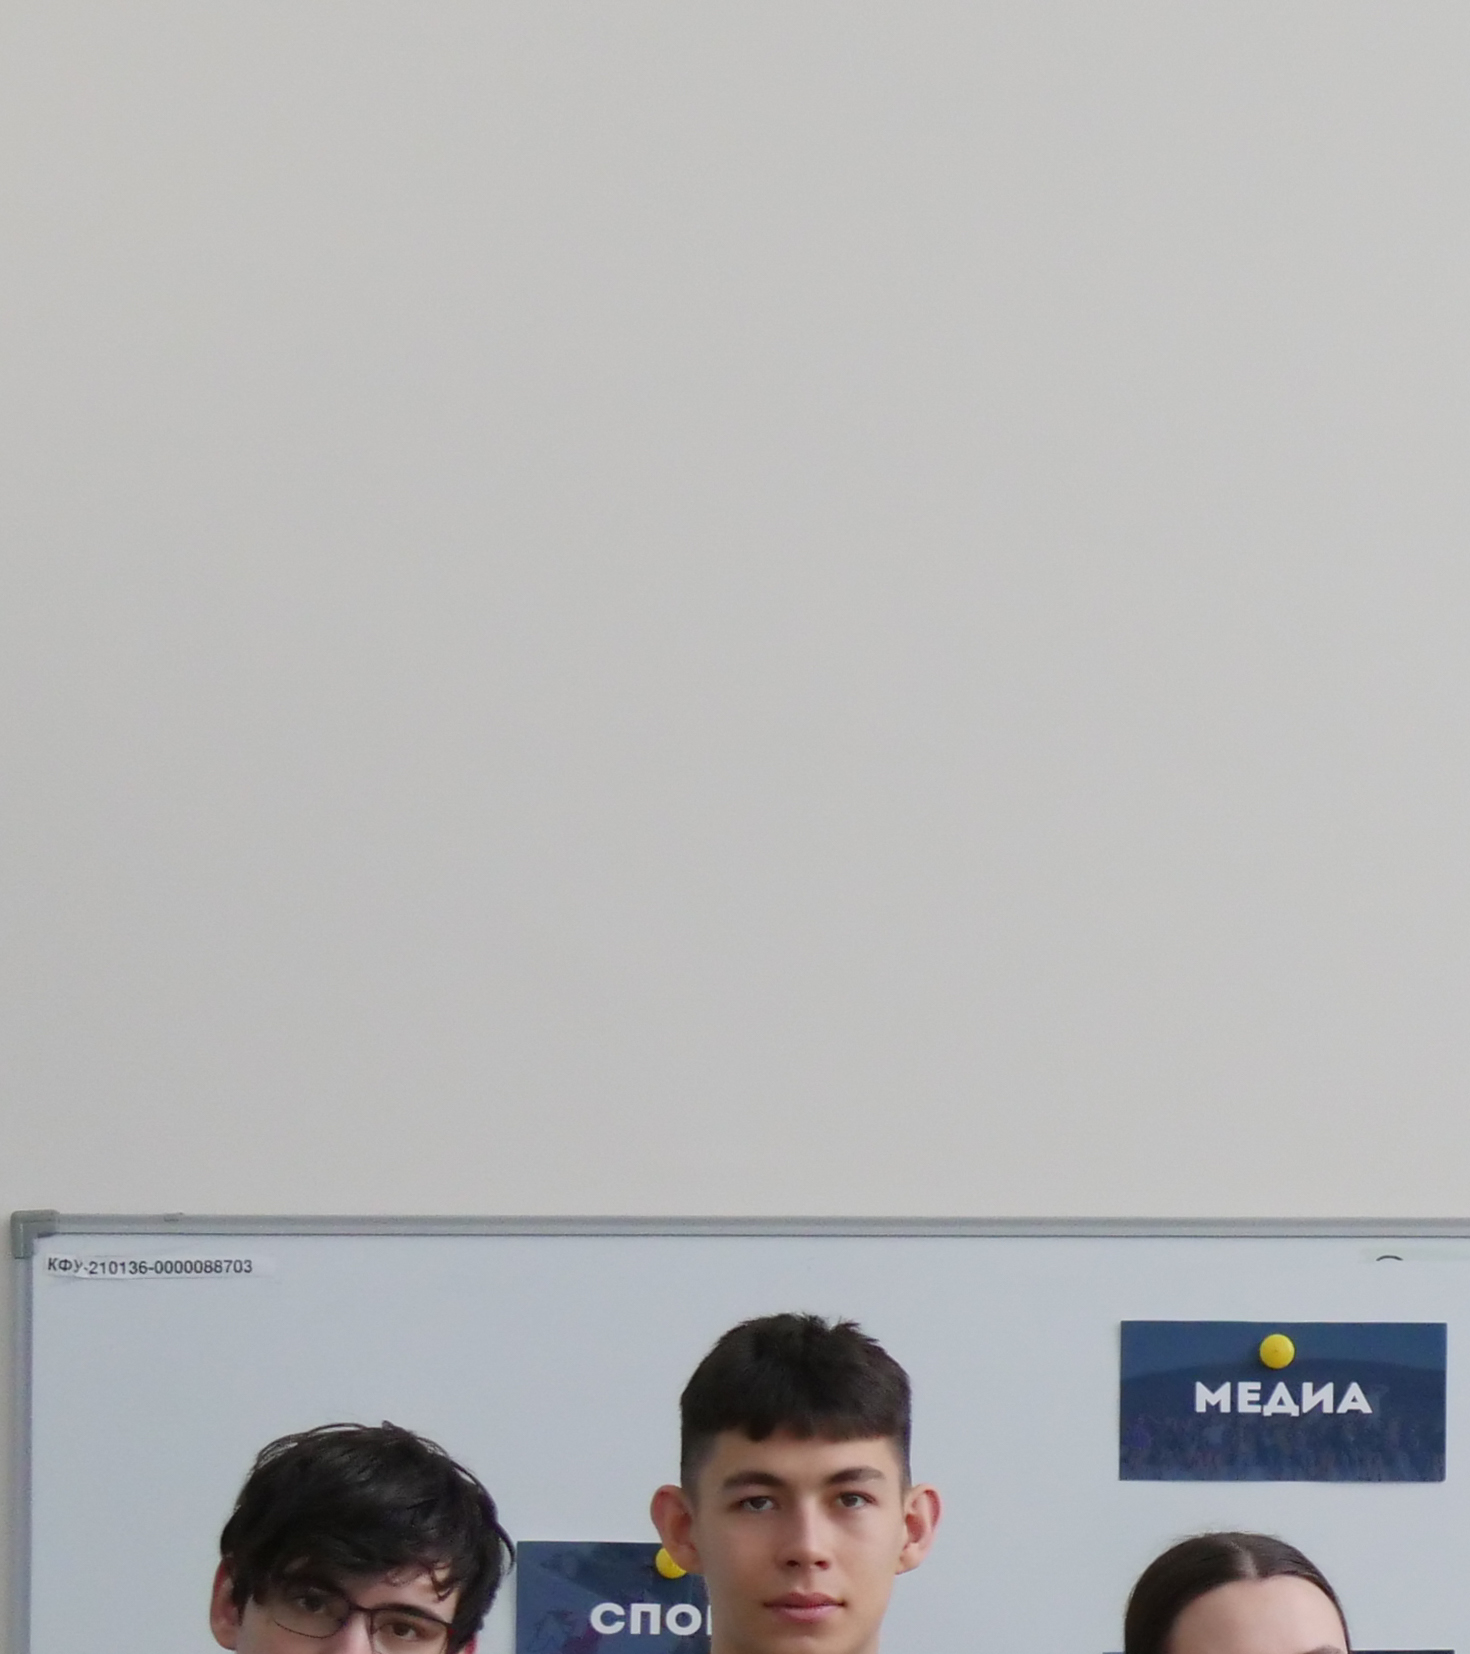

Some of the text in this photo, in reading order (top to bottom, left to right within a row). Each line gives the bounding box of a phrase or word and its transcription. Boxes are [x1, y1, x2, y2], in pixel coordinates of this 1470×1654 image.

[48, 1256, 253, 1275] КФУ-210136-0000088703
[1194, 1381, 1373, 1416] МЕДИА
[590, 1602, 713, 1636] СПО
